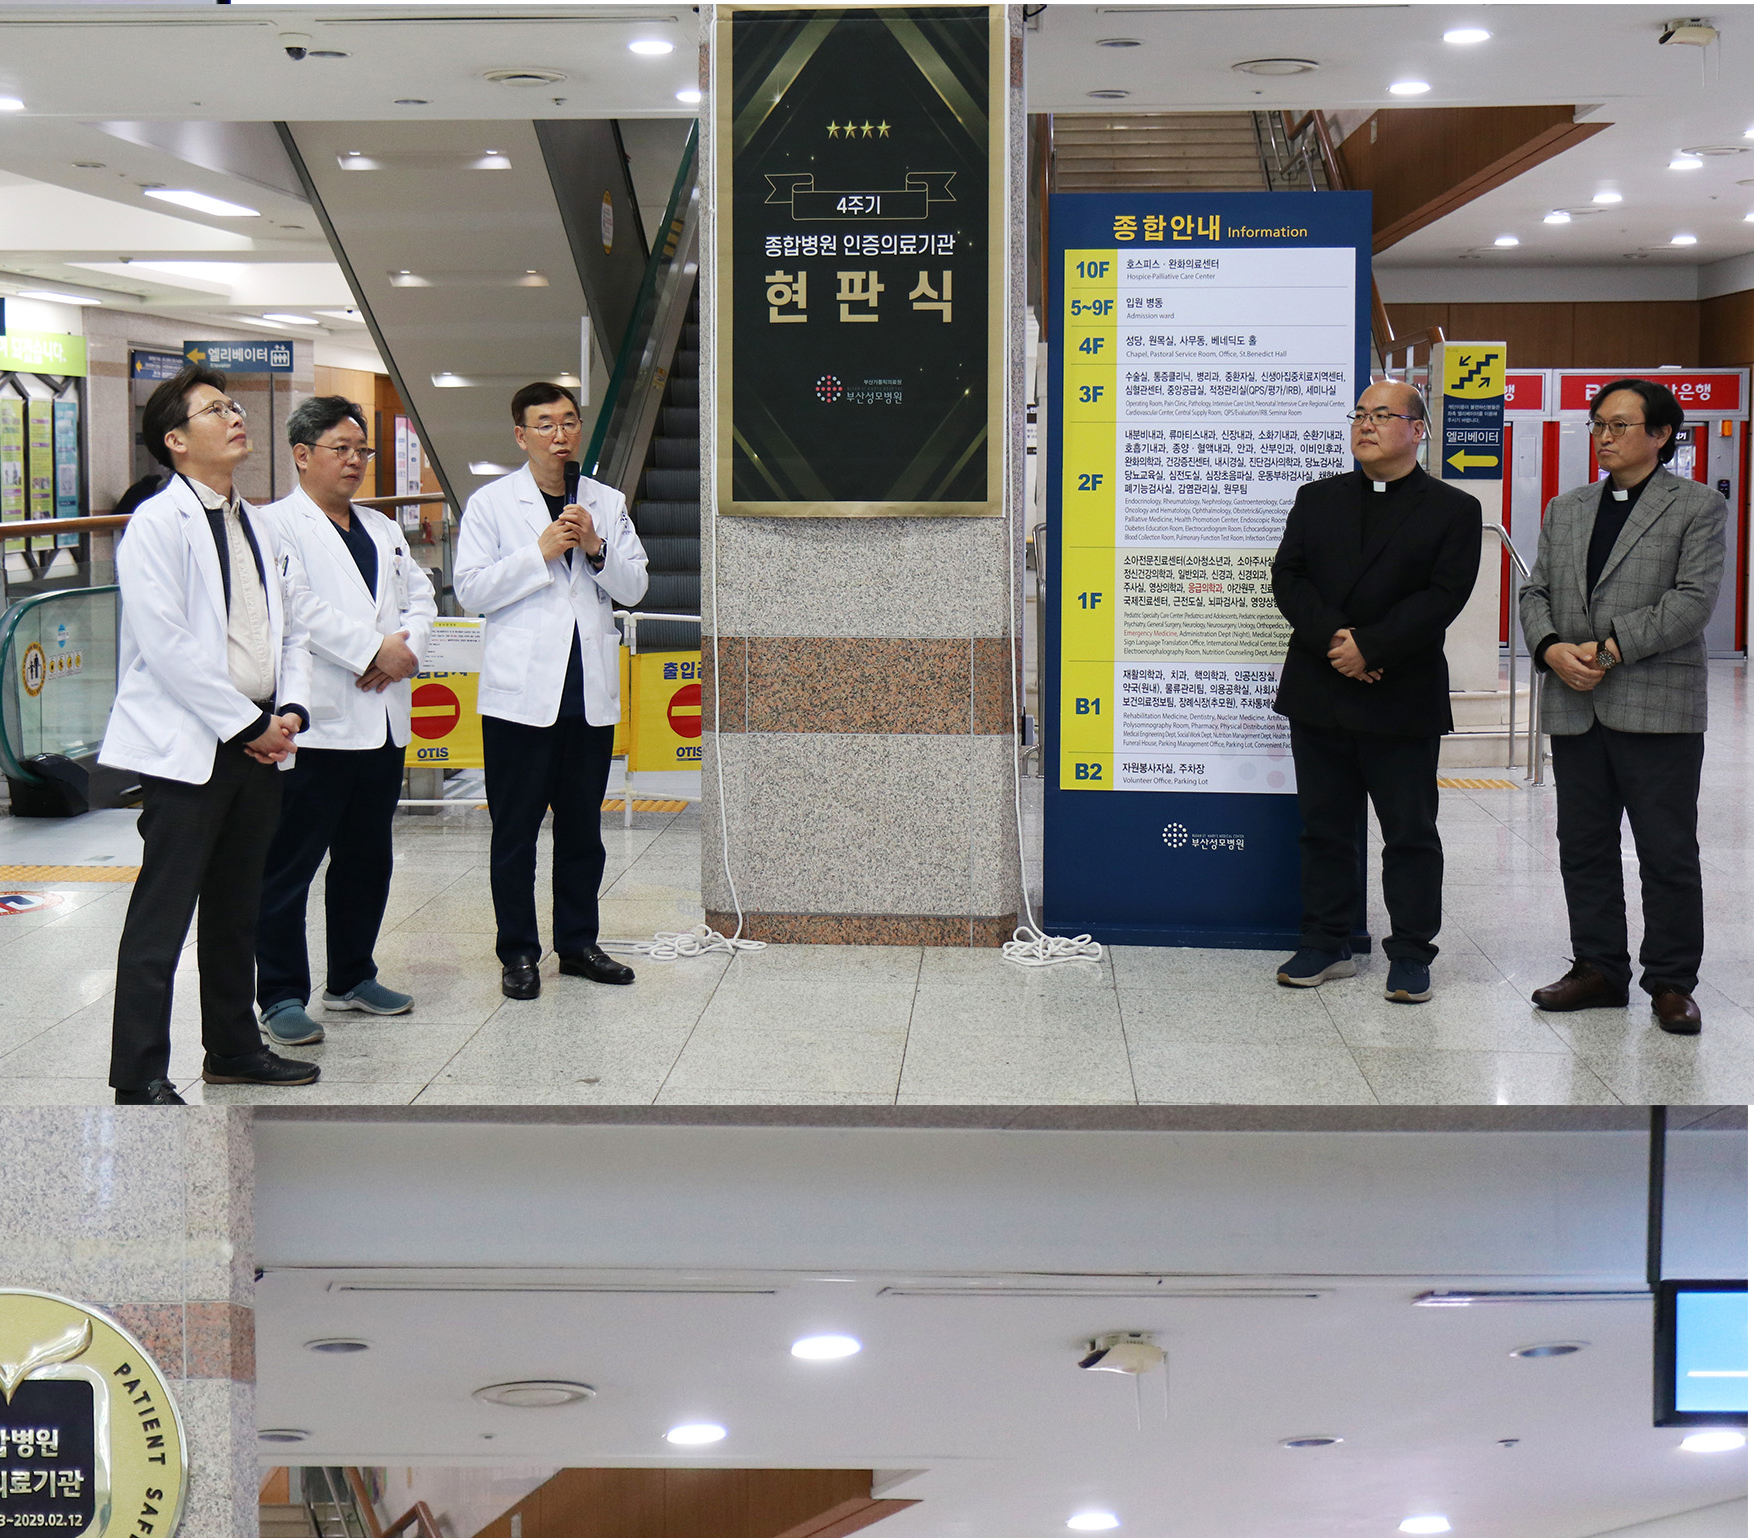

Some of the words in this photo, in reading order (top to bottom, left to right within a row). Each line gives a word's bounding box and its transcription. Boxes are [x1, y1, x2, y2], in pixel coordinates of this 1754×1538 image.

[836, 196, 881, 215] 4주기
[1113, 214, 1221, 241] 종합안내
[1228, 226, 1308, 239] Information
[765, 234, 837, 257] 종합병원
[843, 234, 956, 256] 인증의료기관
[1076, 261, 1110, 278] 10F
[1126, 259, 1160, 270] 호스피스
[1168, 259, 1220, 270] 완화의료센터
[1070, 299, 1114, 316] 5~9F
[1126, 298, 1143, 308] 입원
[1146, 298, 1163, 308] 병동
[1079, 338, 1105, 354] 4F
[1125, 335, 1145, 346] 성당,
[1148, 335, 1176, 346] 원목실,
[1179, 335, 1208, 346] 사무동,
[1211, 335, 1245, 346] 베네딕도
[1248, 335, 1257, 346] 홀
[207, 346, 268, 362] 엘리베이터
[847, 392, 902, 404] 부산성모병원
[1079, 386, 1105, 403] 3F
[1125, 430, 1166, 440] 내분비내과,
[1169, 430, 1218, 440] 류마티스내과,
[1221, 430, 1255, 440] 신장내과,
[1258, 430, 1300, 440] 소화기내과,
[1303, 430, 1345, 440] 순환기내과,
[1446, 431, 1499, 443] 엘리베이터
[1125, 443, 1169, 454] 호흡기내과,
[1172, 443, 1189, 454] 종양
[1197, 443, 1233, 454] 혈액내과,
[1237, 443, 1256, 454] 안과,
[1260, 443, 1296, 454] 산부인과,
[1300, 443, 1345, 454] 이비인후과,
[1078, 474, 1103, 491] 2F
[1078, 592, 1102, 608] 1F
[1123, 670, 1165, 682] 재활의학과,
[1170, 670, 1190, 682] 치과,
[1195, 670, 1229, 682] 핵의학과,
[1235, 670, 1278, 682] 인공신장실,
[1075, 698, 1101, 715] B1
[417, 747, 449, 759] OTIS
[1075, 763, 1102, 780] B2
[1122, 763, 1176, 774] 자원봉사자실,
[1179, 763, 1205, 774] 주차장
[1192, 838, 1244, 850] 부산성모병원
[113, 1362, 166, 1465] PATIENT
